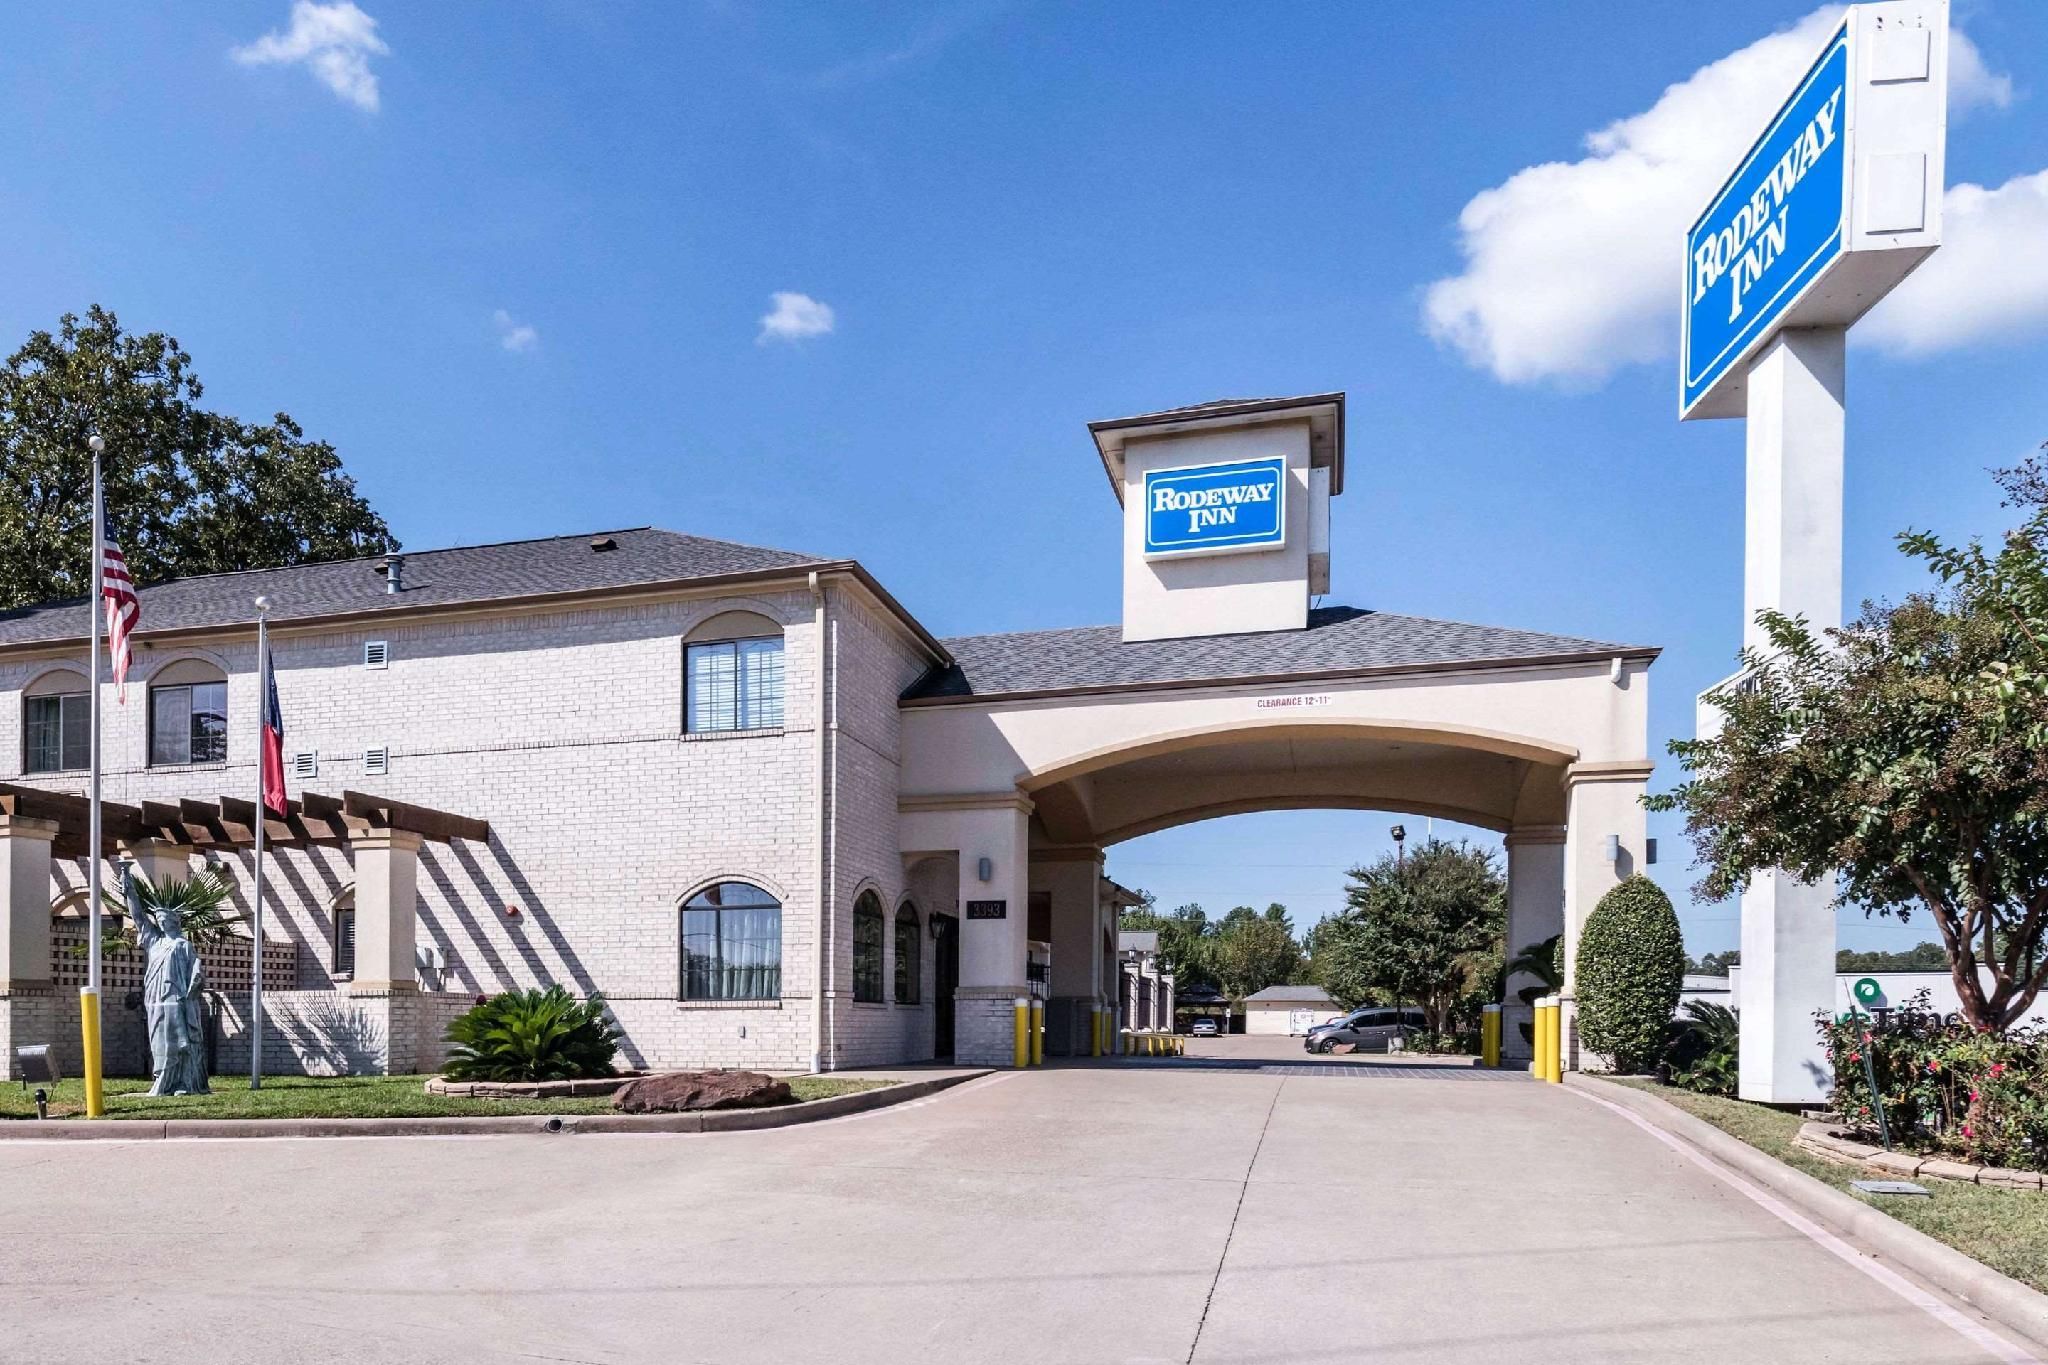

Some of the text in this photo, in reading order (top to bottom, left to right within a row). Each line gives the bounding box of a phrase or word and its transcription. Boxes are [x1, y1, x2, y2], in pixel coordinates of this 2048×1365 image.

[1693, 85, 1842, 306] RODEWAY
[1729, 205, 1789, 325] INN
[1153, 483, 1275, 512] RODEWAY
[1188, 506, 1238, 533] INN
[1257, 697, 1302, 708] CLEARANCE
